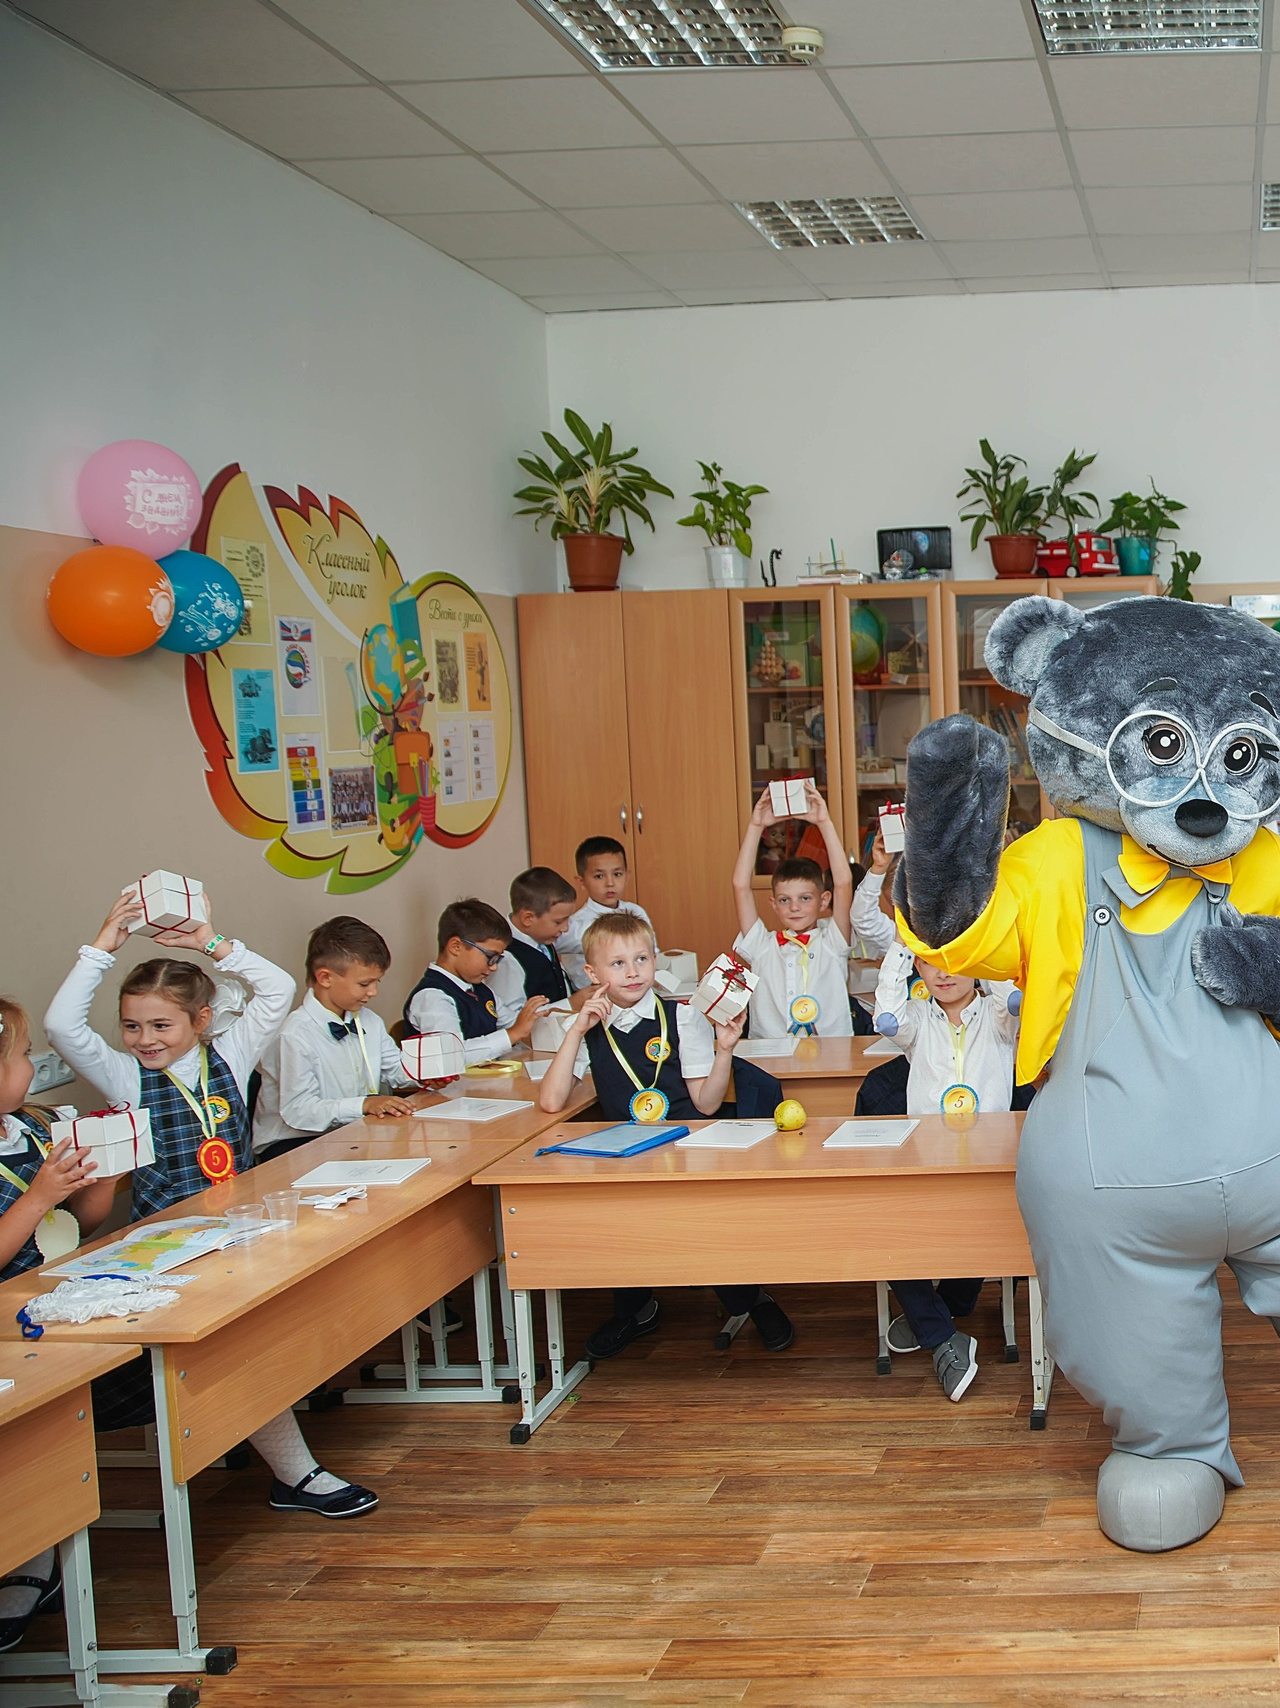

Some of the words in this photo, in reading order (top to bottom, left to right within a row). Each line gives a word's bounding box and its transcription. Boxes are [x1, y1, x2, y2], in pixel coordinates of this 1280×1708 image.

[302, 533, 370, 579] Классный
[326, 580, 368, 605] уголок
[916, 985, 924, 996] 5
[800, 1003, 808, 1014] 5
[644, 1098, 653, 1111] 5
[954, 1095, 965, 1108] 5
[211, 1150, 220, 1166] 5
